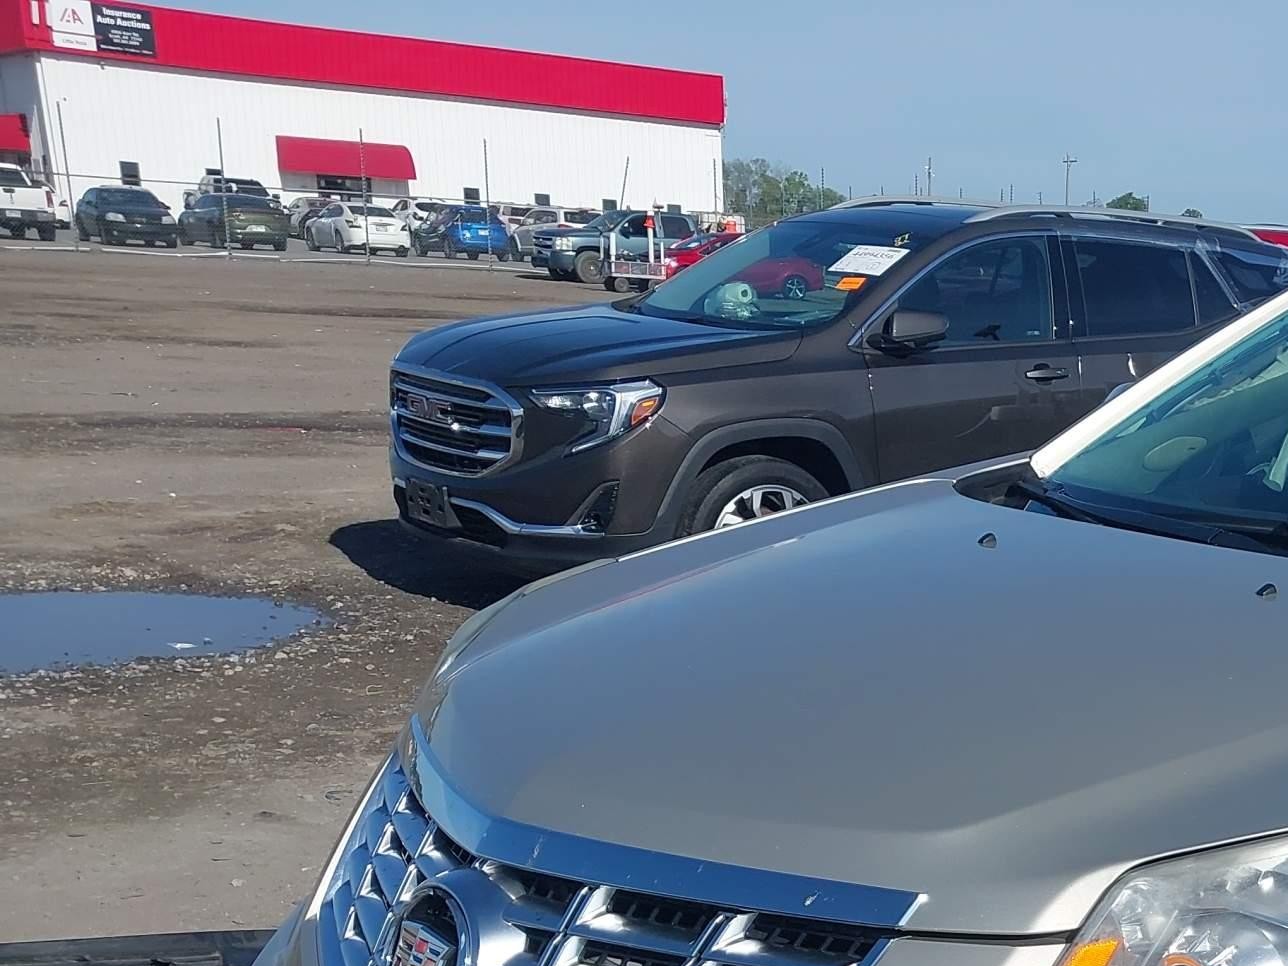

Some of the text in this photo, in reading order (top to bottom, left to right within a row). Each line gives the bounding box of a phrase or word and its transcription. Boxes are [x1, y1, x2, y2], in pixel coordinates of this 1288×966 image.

[102, 7, 142, 20] Insurance
[96, 15, 151, 30] Auto Auctions
[407, 393, 452, 424] GMC
